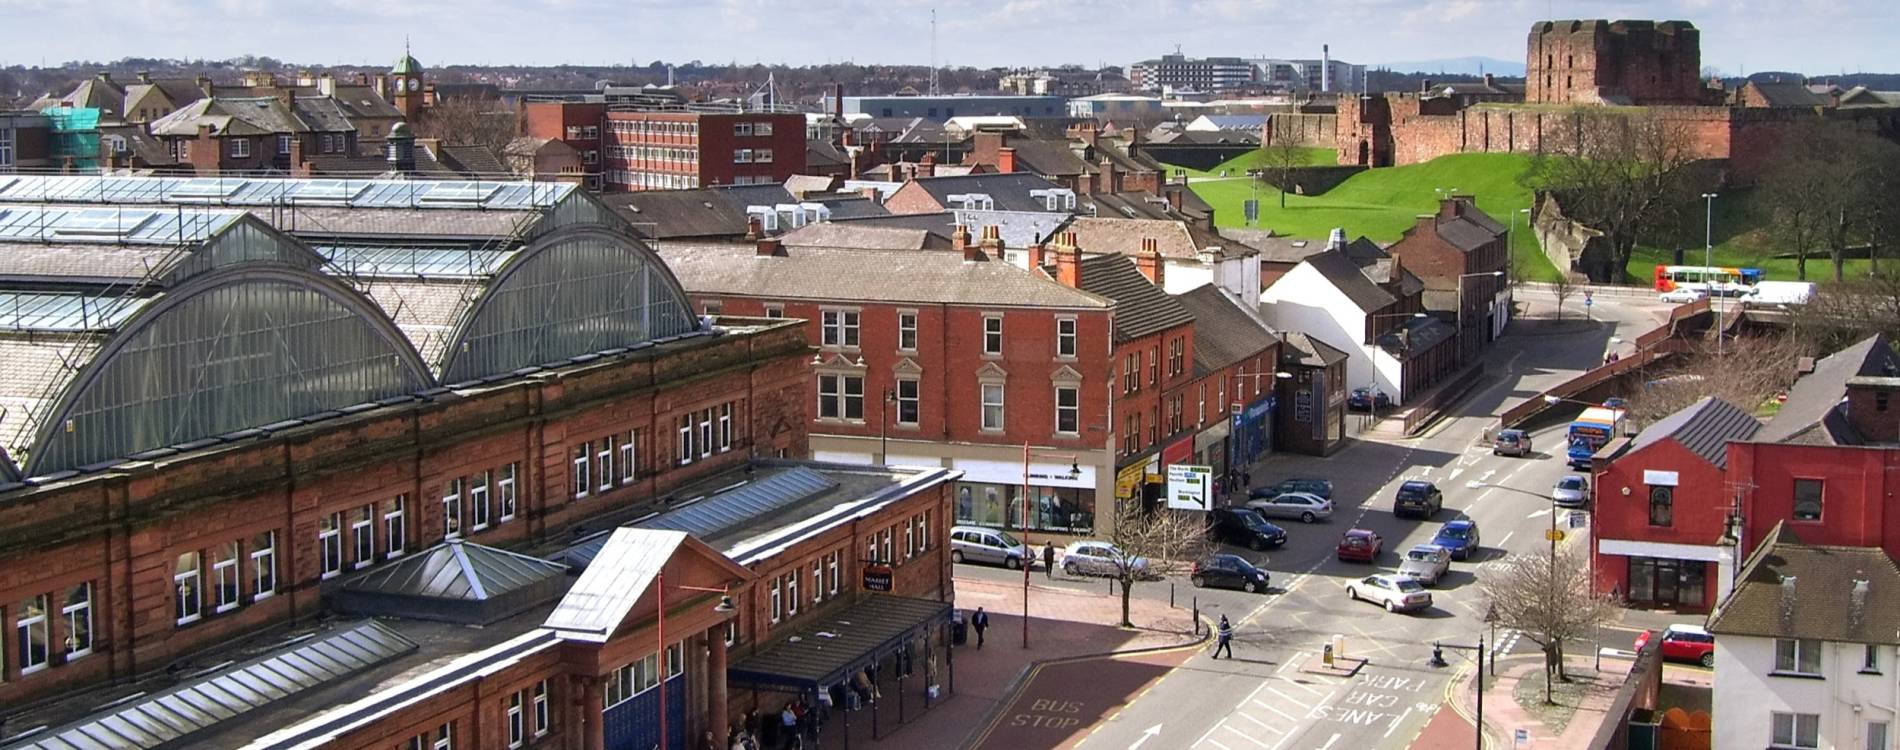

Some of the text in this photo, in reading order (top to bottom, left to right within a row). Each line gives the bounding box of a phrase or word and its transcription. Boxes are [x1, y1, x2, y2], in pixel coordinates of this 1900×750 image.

[1358, 674, 1426, 692] PARK
[1031, 698, 1084, 713] BUS
[1345, 690, 1399, 708] CAR
[1011, 714, 1080, 729] STOP
[1312, 704, 1402, 727] LANES
